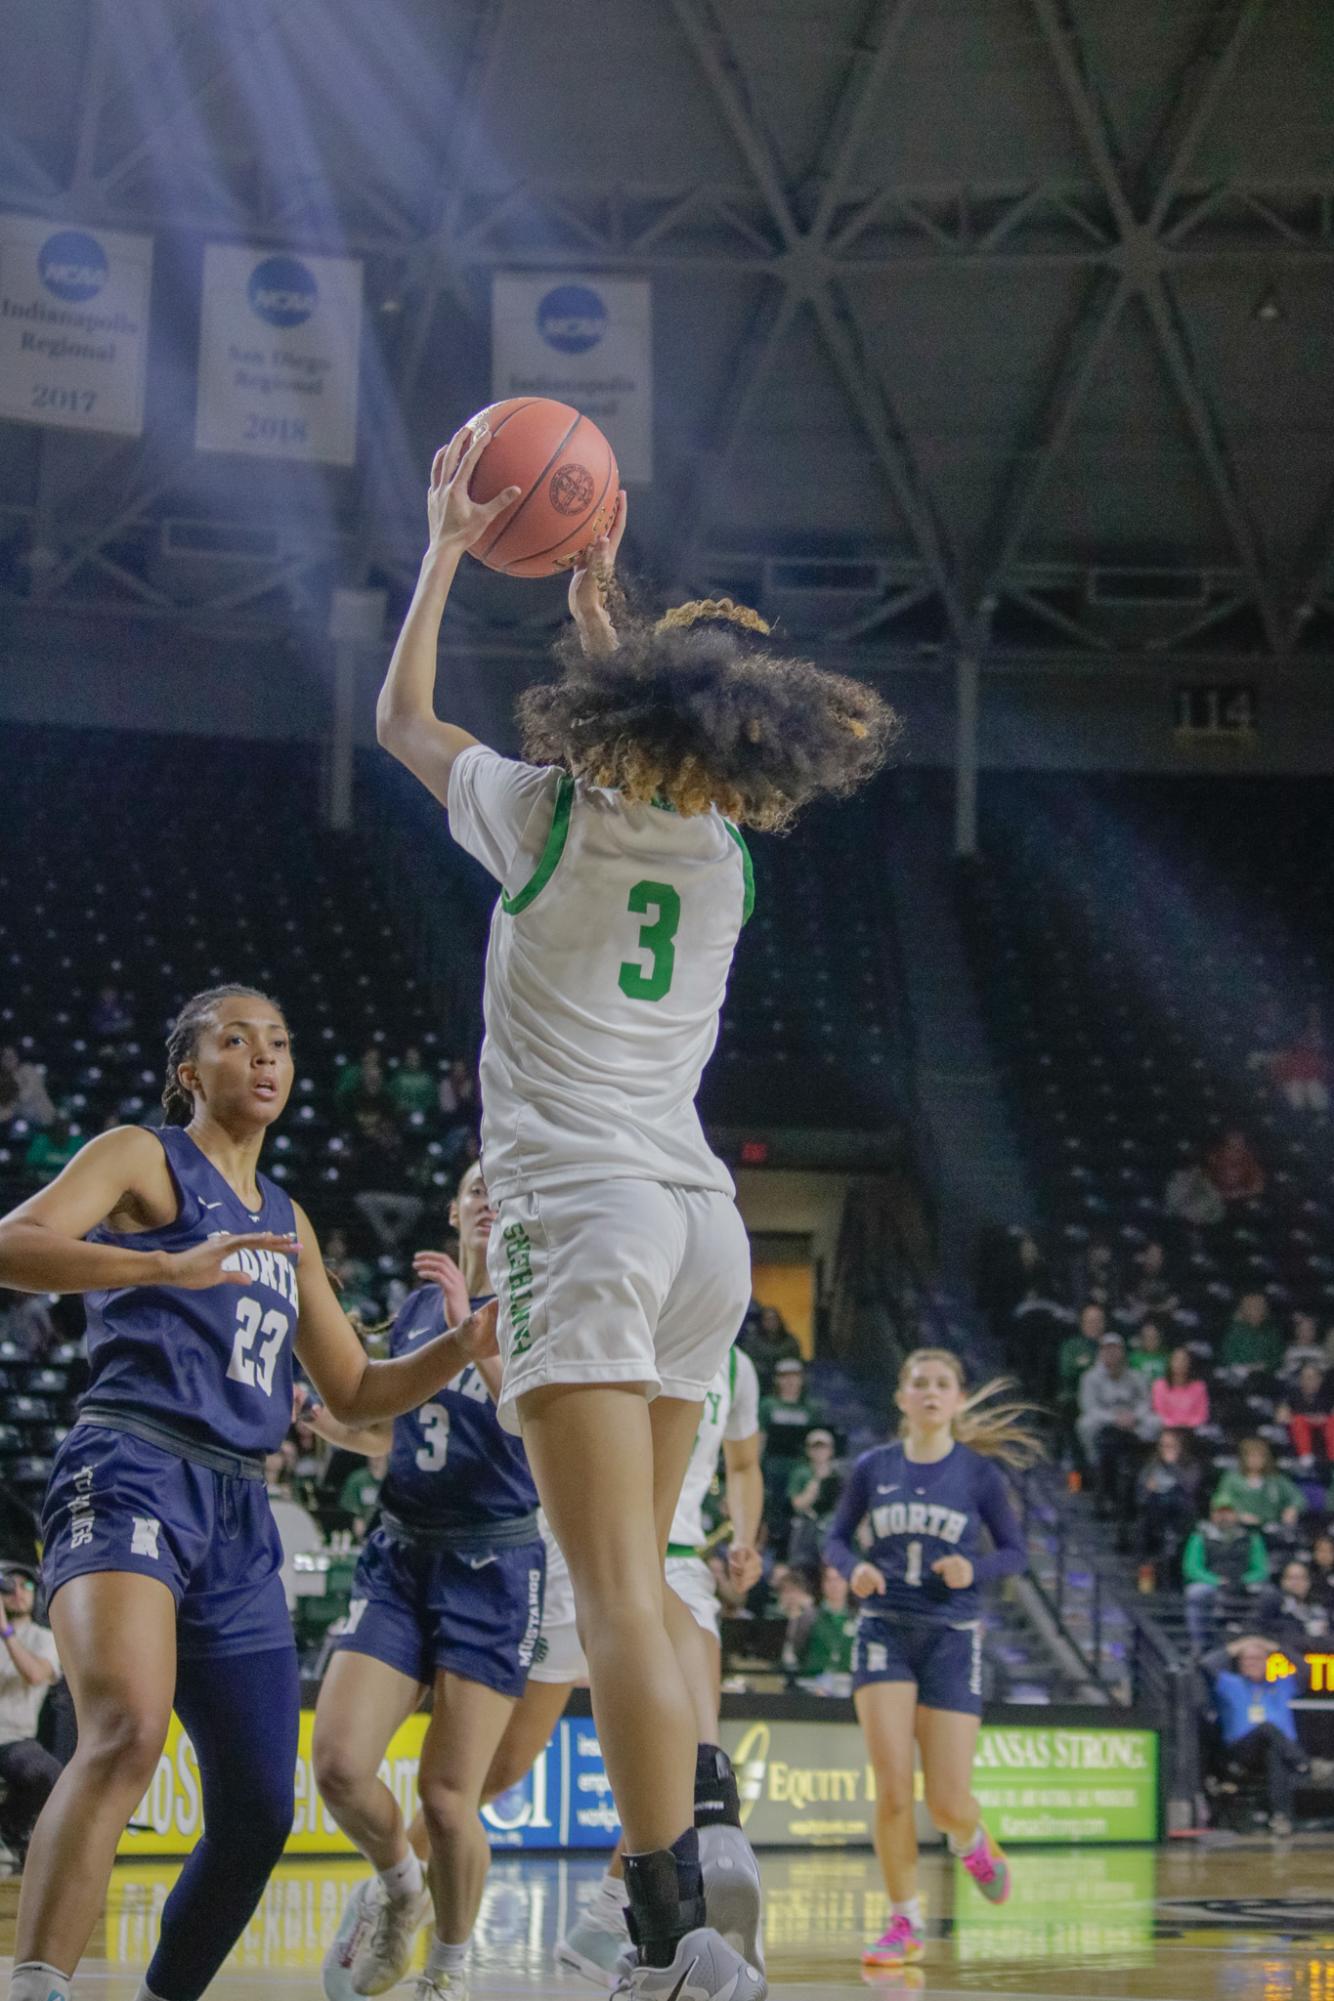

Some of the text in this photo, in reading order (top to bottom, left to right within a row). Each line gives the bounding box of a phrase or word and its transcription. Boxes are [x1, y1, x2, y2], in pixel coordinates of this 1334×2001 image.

[20, 331, 116, 363] Regional
[32, 383, 98, 412] 2017
[617, 879, 682, 1003] 3
[225, 1296, 289, 1397] 23
[415, 1402, 450, 1472] 3
[872, 1502, 968, 1544] NORTH
[904, 1540, 923, 1587] 1
[518, 1569, 541, 1667] MUSTANGS
[972, 1731, 1050, 1769] ANSAS
